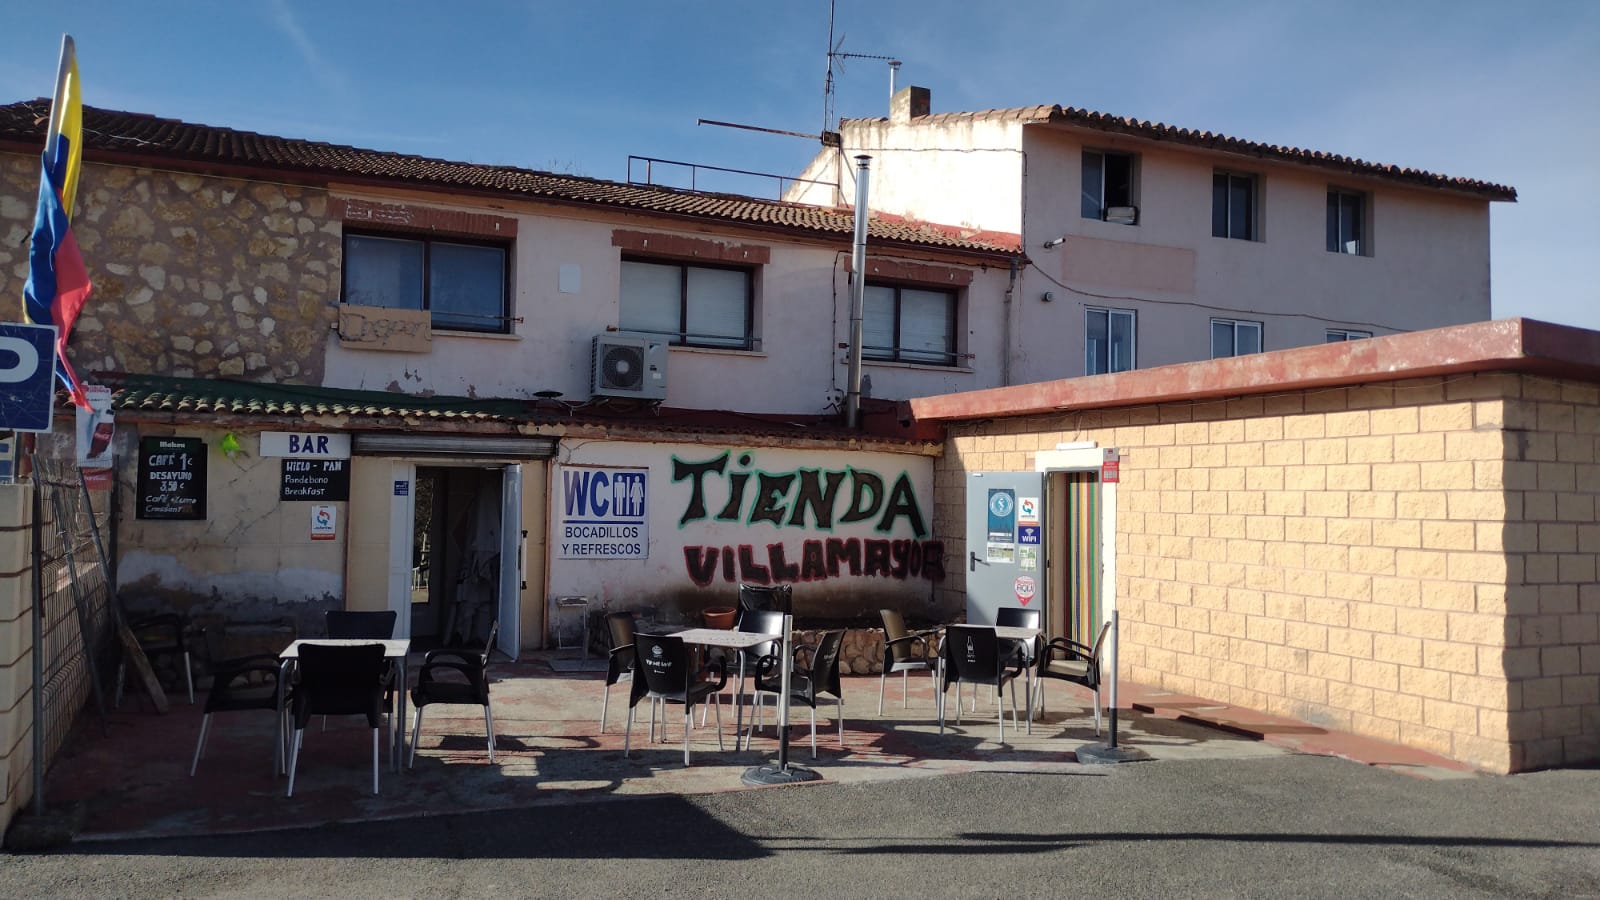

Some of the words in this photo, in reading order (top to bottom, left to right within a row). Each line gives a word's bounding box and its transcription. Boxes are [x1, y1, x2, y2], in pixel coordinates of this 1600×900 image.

[289, 435, 329, 454] BAR
[149, 471, 193, 480] DESAYUNO
[563, 470, 610, 517] WC
[565, 526, 639, 539] BOCADILLOS
[562, 543, 570, 555] Y
[572, 543, 641, 555] REFRESCOS
